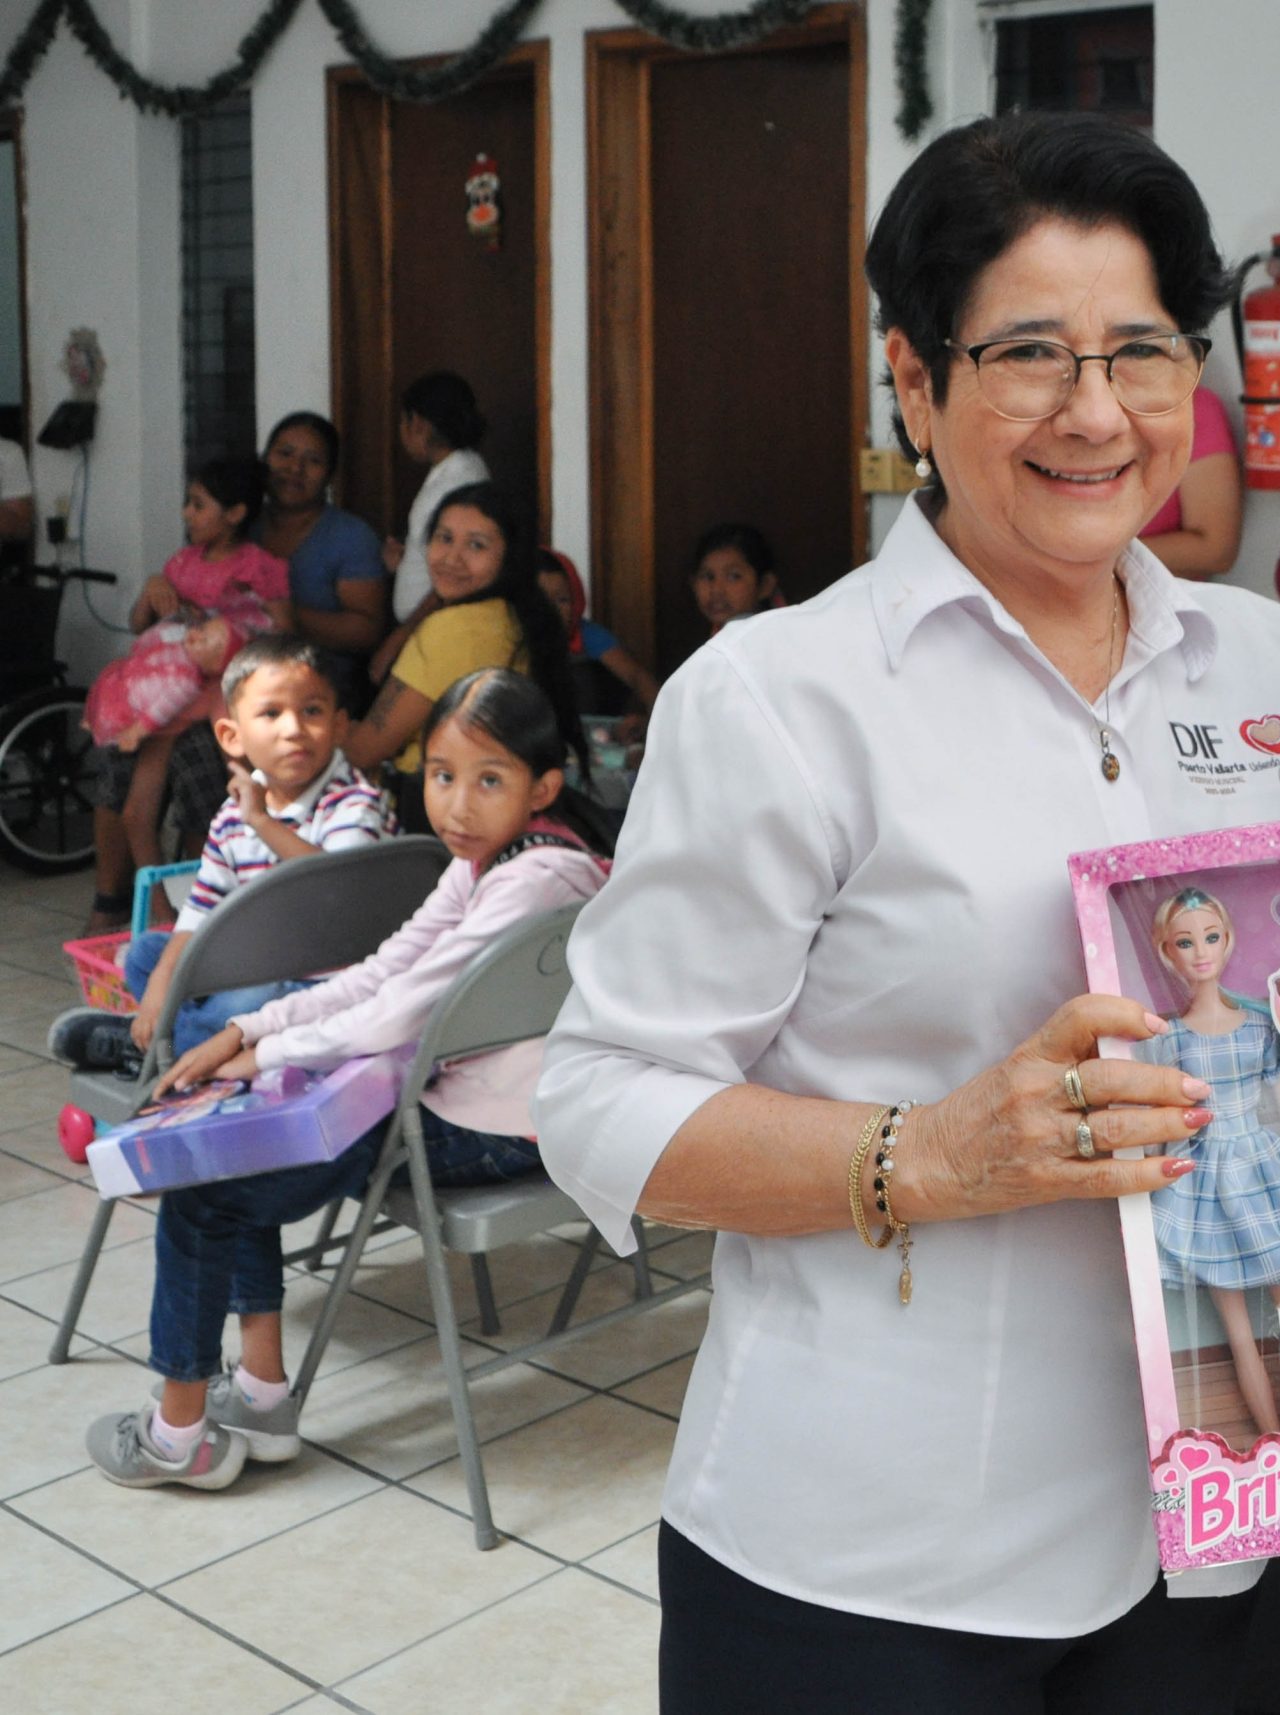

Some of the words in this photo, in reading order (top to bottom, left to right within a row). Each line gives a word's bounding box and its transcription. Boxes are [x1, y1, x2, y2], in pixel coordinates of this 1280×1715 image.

[1169, 721, 1223, 759] DIF
[1177, 760, 1206, 774] Puerto
[1205, 763, 1247, 775] Vallarta
